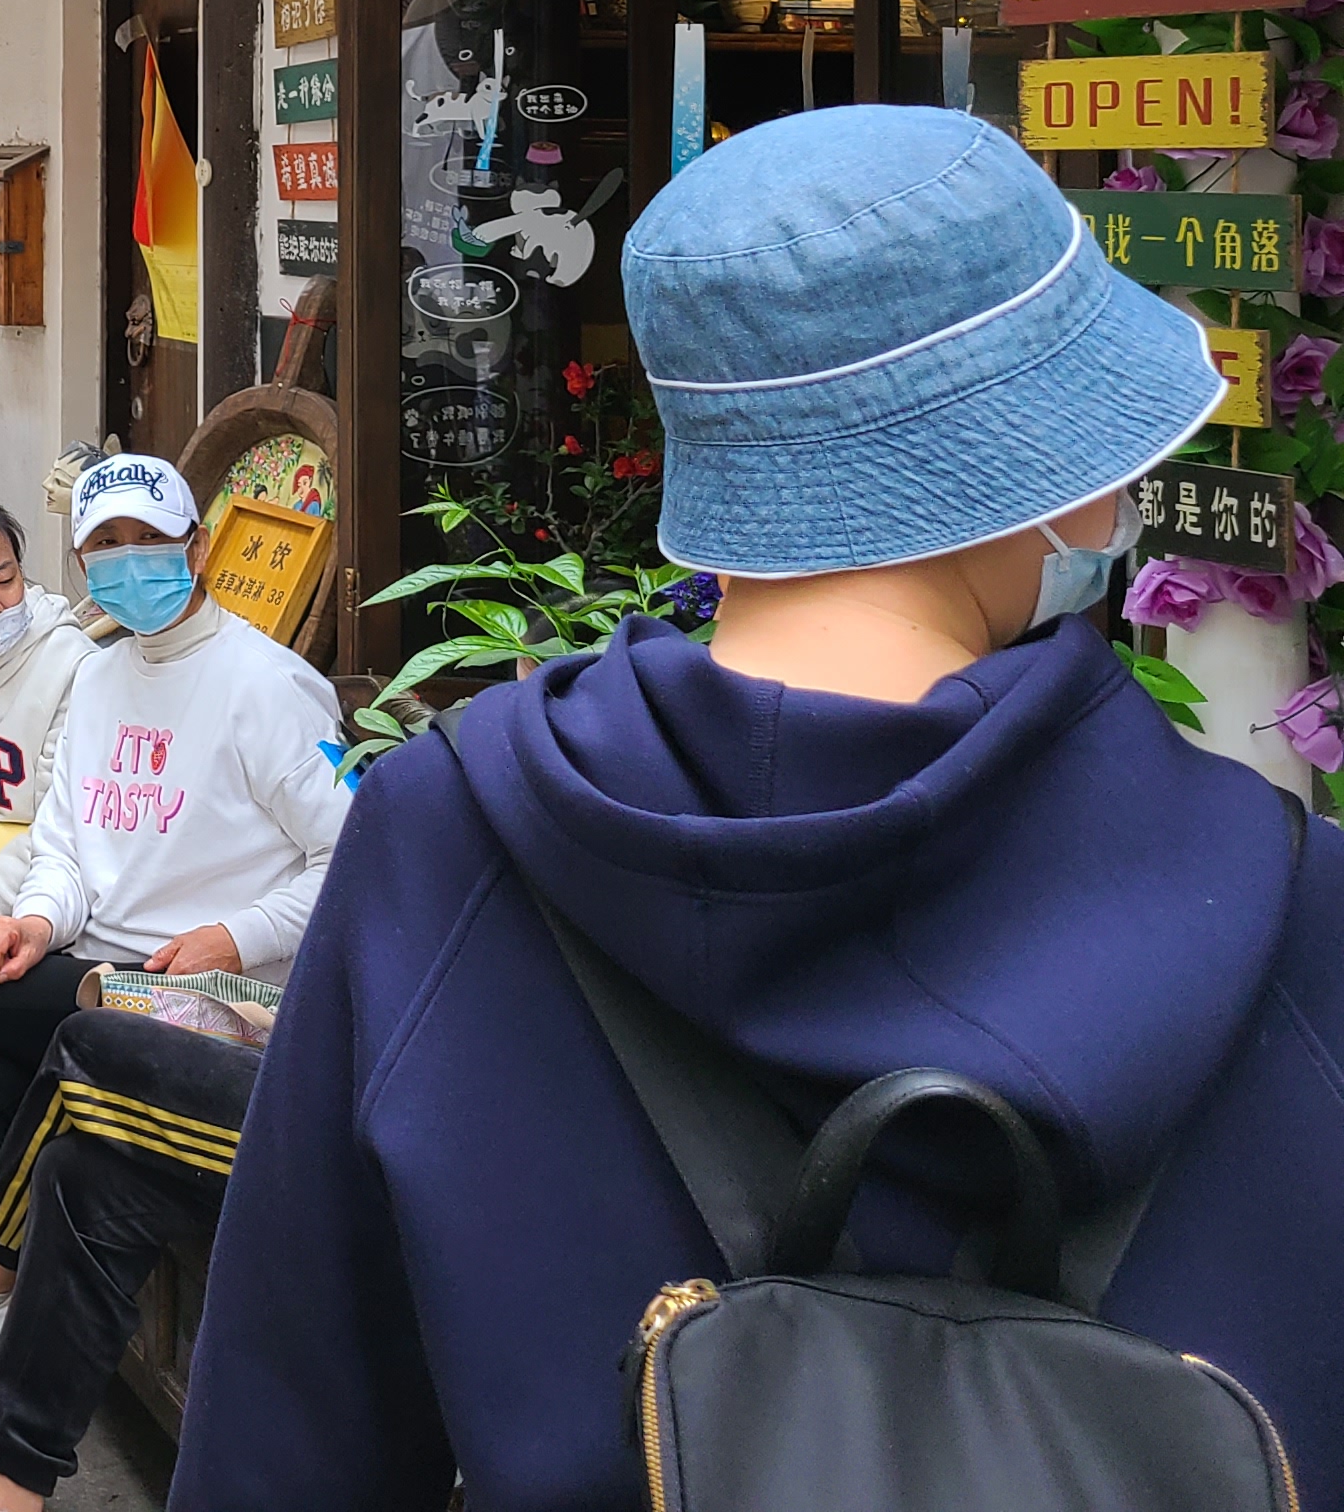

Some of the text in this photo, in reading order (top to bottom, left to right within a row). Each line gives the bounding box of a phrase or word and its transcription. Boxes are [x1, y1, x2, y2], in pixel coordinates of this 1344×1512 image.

[276, 73, 336, 111] 是一种缘分
[1043, 76, 1242, 129] OPEN!
[1138, 475, 1277, 548] 都是你的
[241, 535, 292, 571] 冰饮
[266, 588, 285, 606] 38
[81, 776, 185, 834] TASTY
